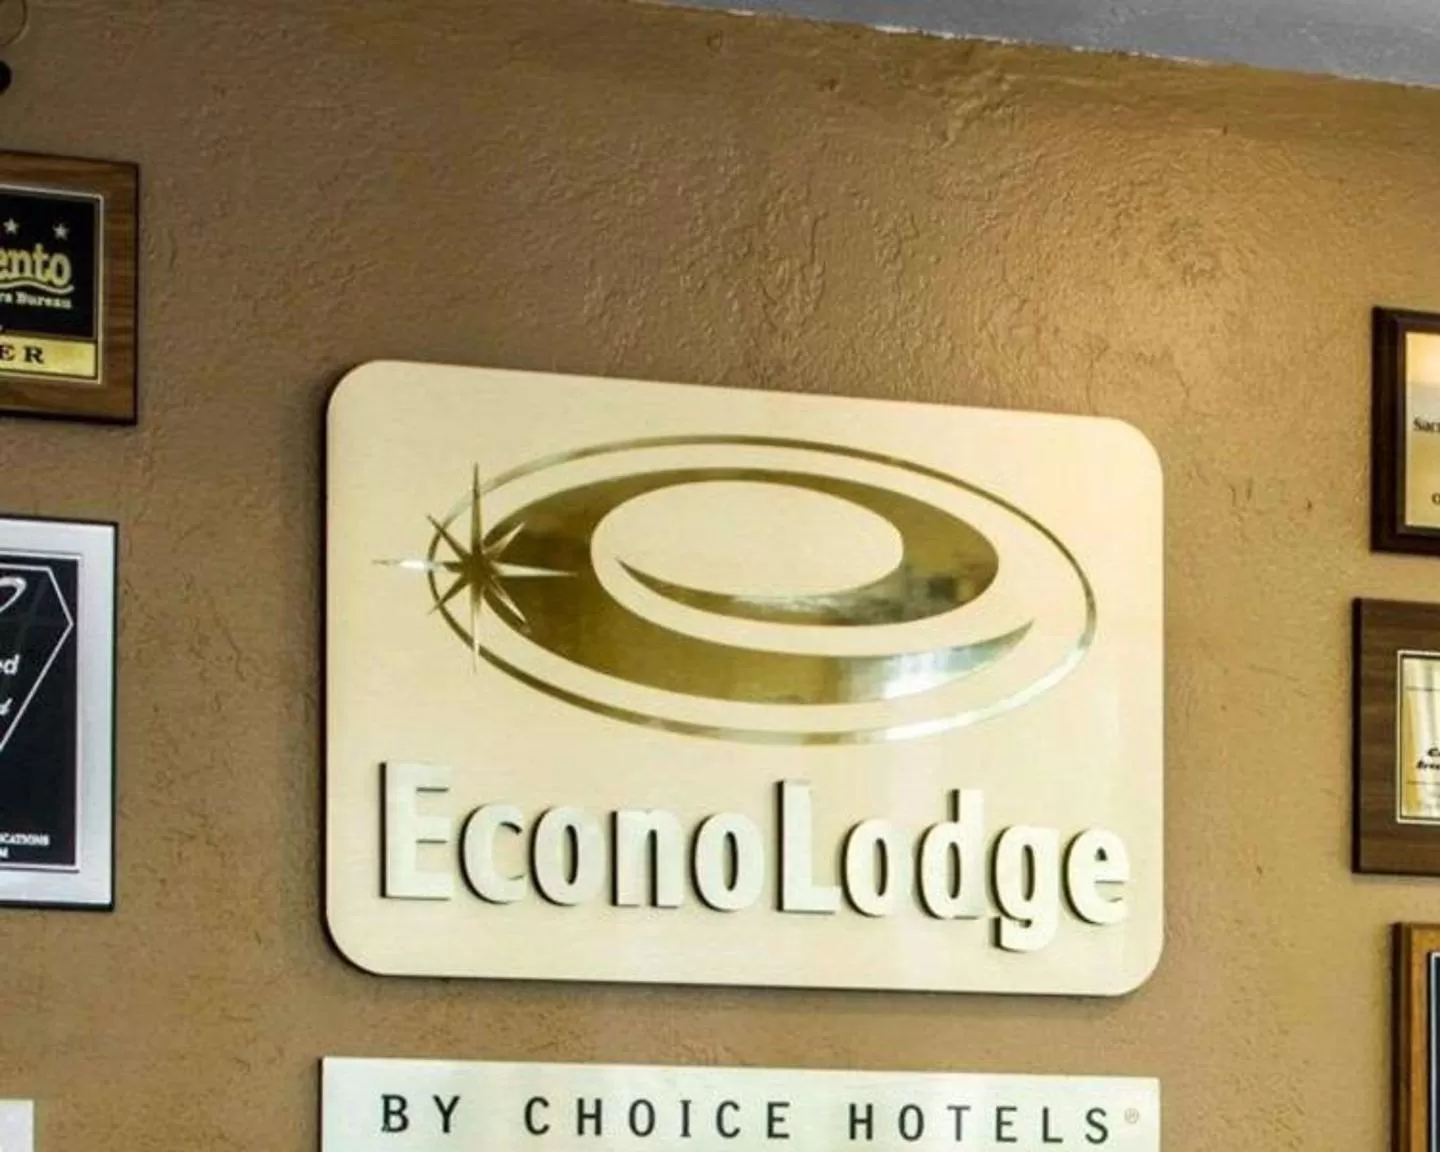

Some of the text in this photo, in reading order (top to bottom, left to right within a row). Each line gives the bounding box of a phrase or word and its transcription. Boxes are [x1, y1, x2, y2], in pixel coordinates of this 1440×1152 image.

[0, 344, 44, 364] ER
[378, 760, 1130, 951] EconoLodge
[381, 1094, 1109, 1144] BY CHOICE HOTELS
